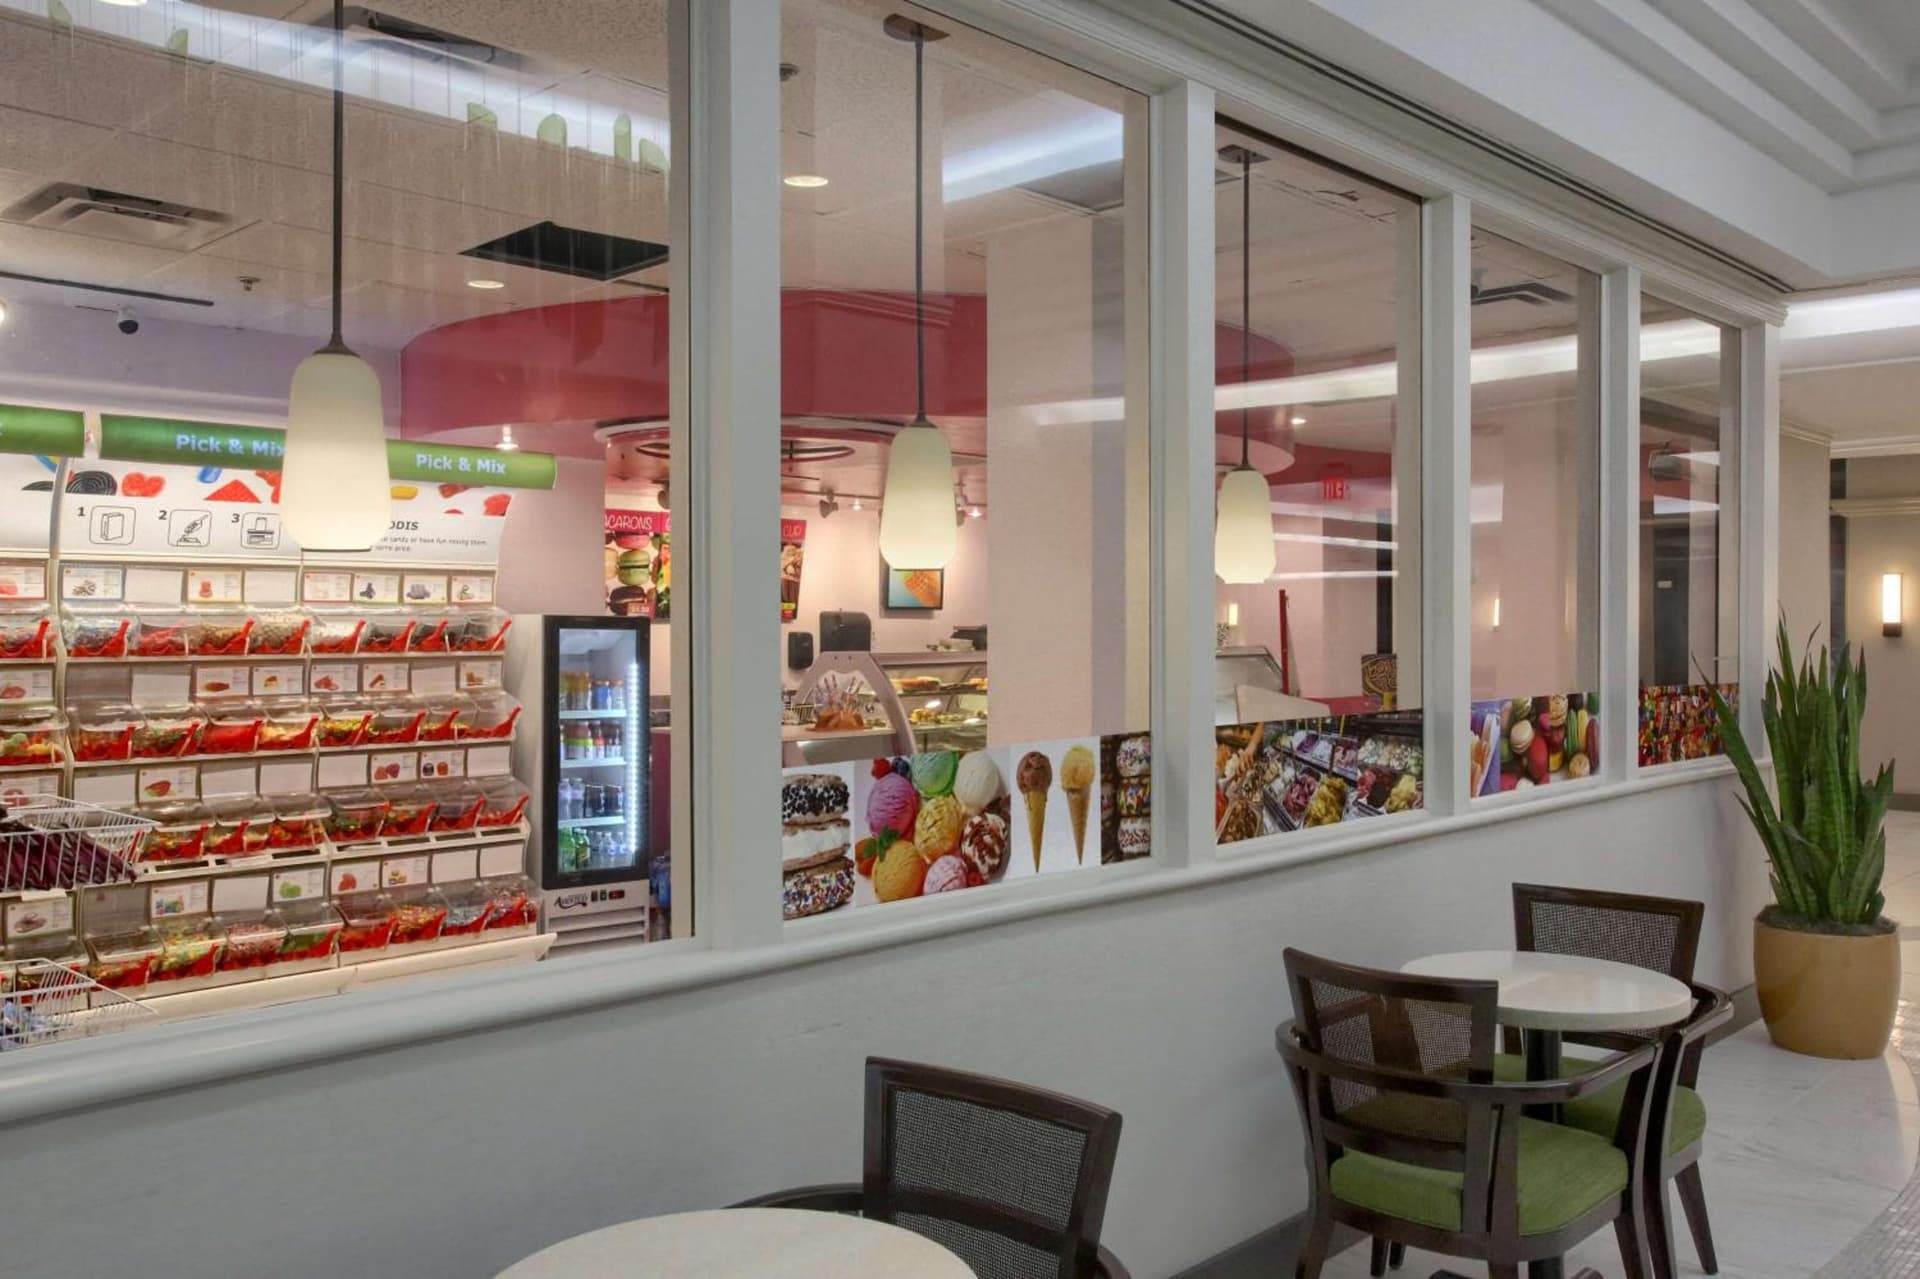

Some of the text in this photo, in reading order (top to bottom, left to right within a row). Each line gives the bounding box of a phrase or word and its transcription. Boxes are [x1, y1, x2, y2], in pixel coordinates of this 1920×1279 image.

[175, 433, 222, 453] Pick
[228, 438, 244, 453] &
[416, 454, 507, 475] Pick & Mix
[77, 507, 85, 517] 1
[158, 510, 168, 520] 2
[231, 513, 240, 524] 3
